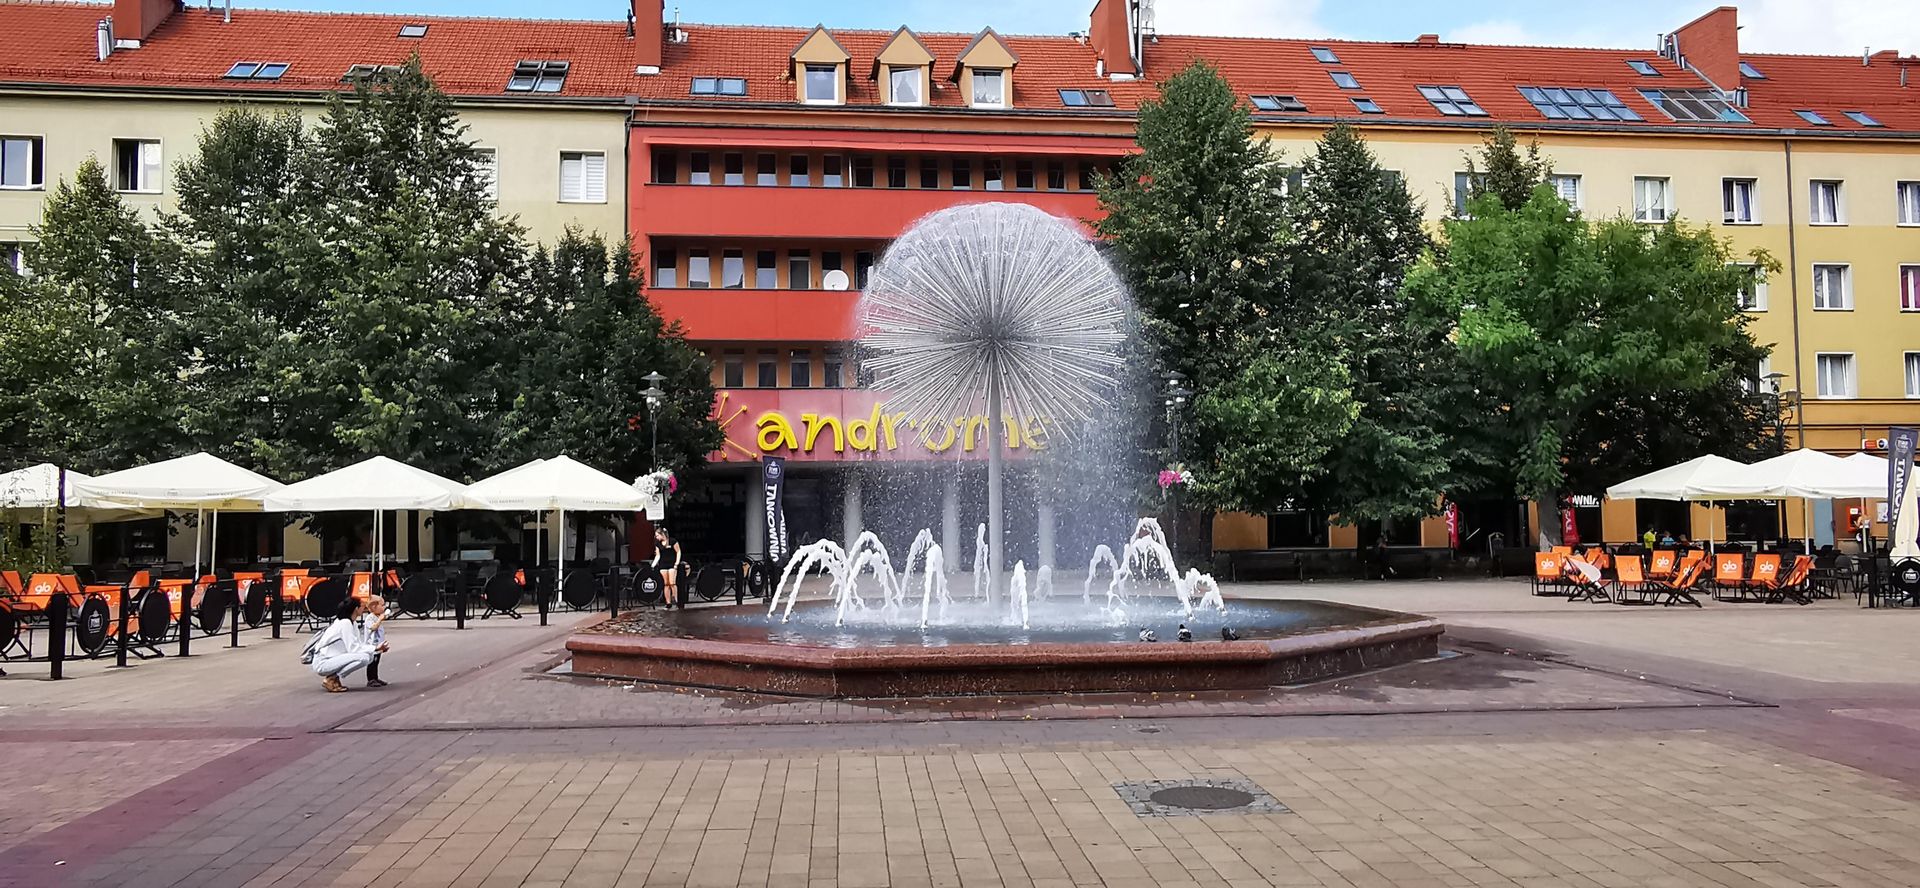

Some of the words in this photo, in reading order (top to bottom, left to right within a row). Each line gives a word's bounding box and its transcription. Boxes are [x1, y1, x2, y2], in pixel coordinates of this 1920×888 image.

[1541, 558, 1555, 570] glo
[1656, 556, 1670, 568] glo
[1722, 560, 1738, 571] glo
[1760, 561, 1775, 571] glo
[35, 582, 52, 594] glo
